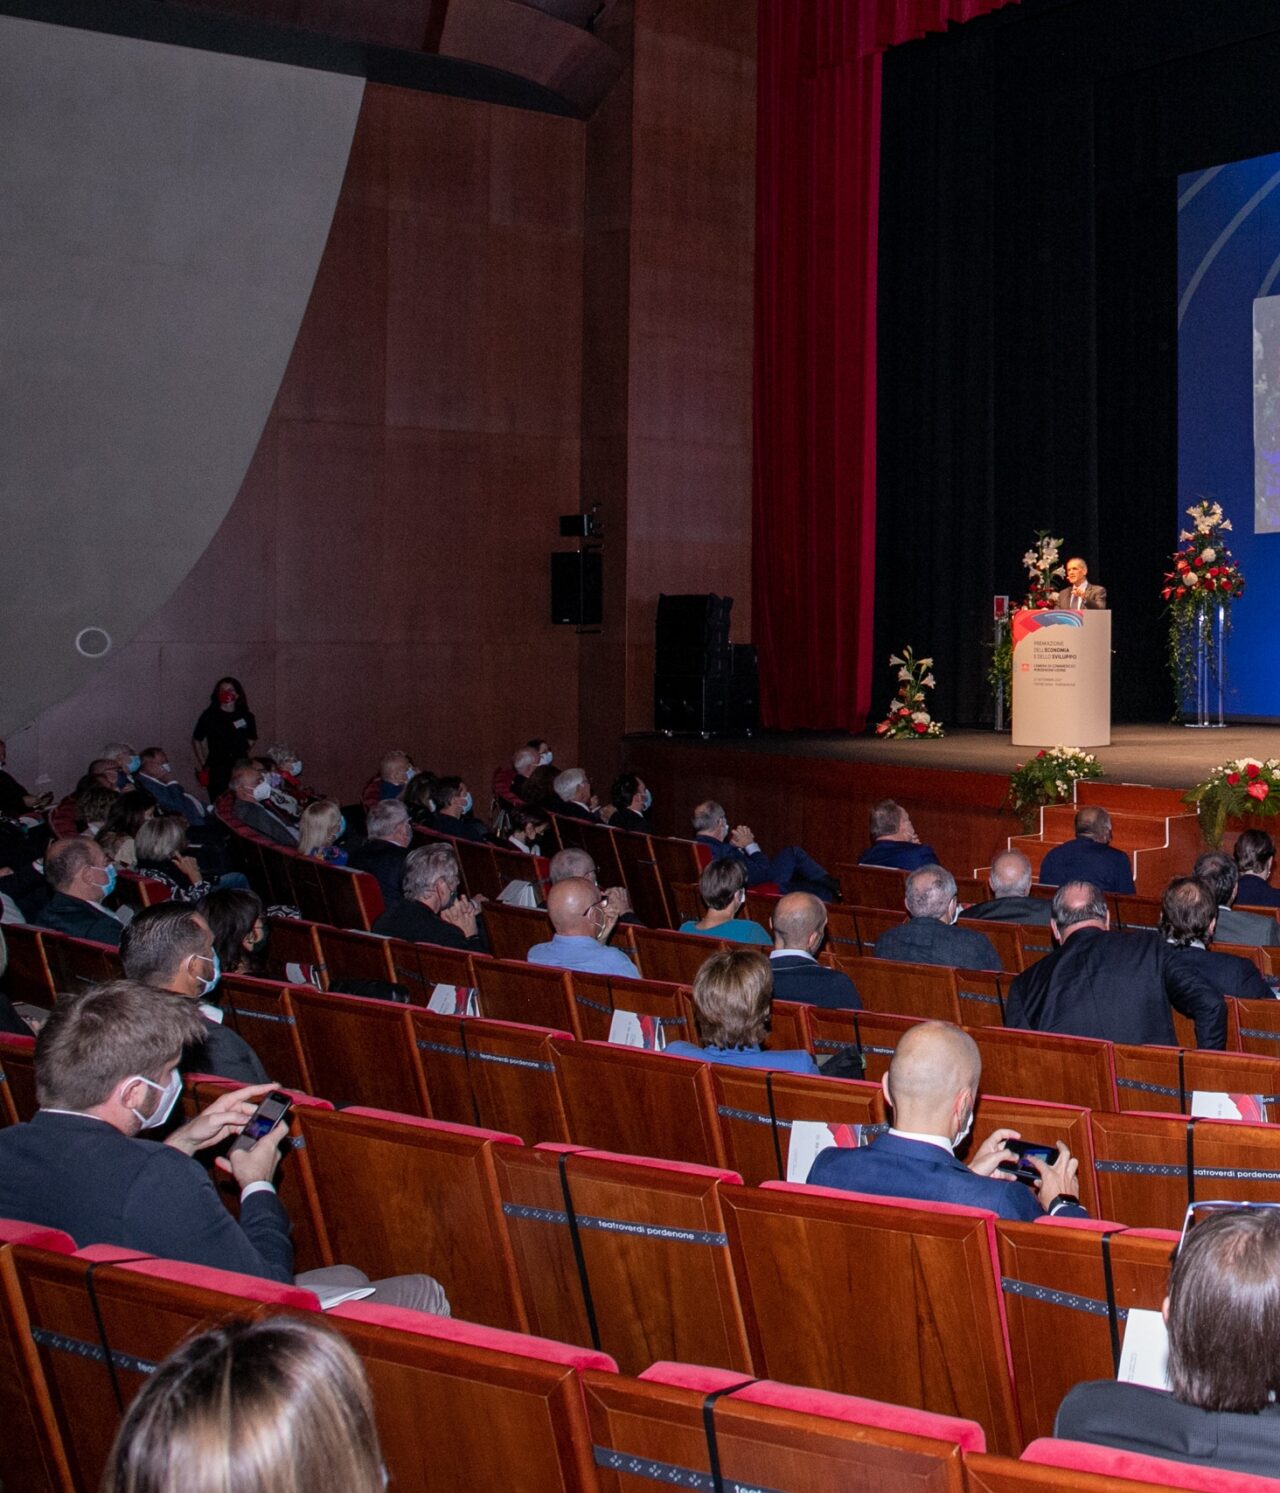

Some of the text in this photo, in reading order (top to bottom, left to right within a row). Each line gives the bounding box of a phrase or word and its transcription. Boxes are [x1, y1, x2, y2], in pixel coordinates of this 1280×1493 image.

[1193, 1168, 1236, 1178] eatroverdi
[598, 1220, 695, 1241] teatroverdi pordenone
